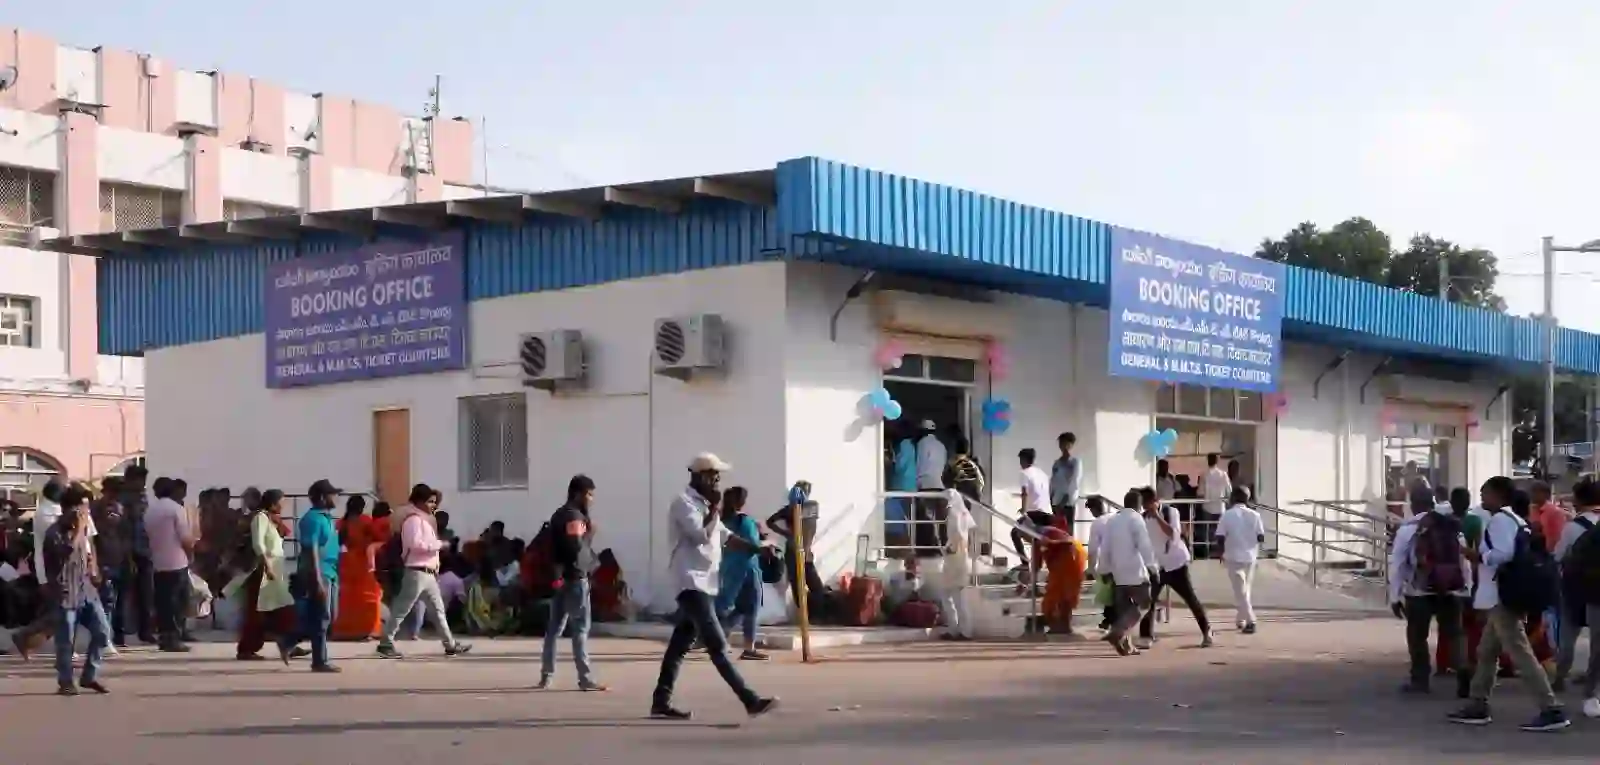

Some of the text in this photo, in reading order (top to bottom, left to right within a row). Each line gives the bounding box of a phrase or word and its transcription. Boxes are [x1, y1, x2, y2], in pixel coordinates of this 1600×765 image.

[291, 287, 366, 317] BOOKING
[372, 275, 433, 305] OFFICE
[1140, 277, 1261, 321] BOOKING OFFICE
[1121, 352, 1160, 368] GENERAL
[1204, 364, 1231, 377] TICKET
